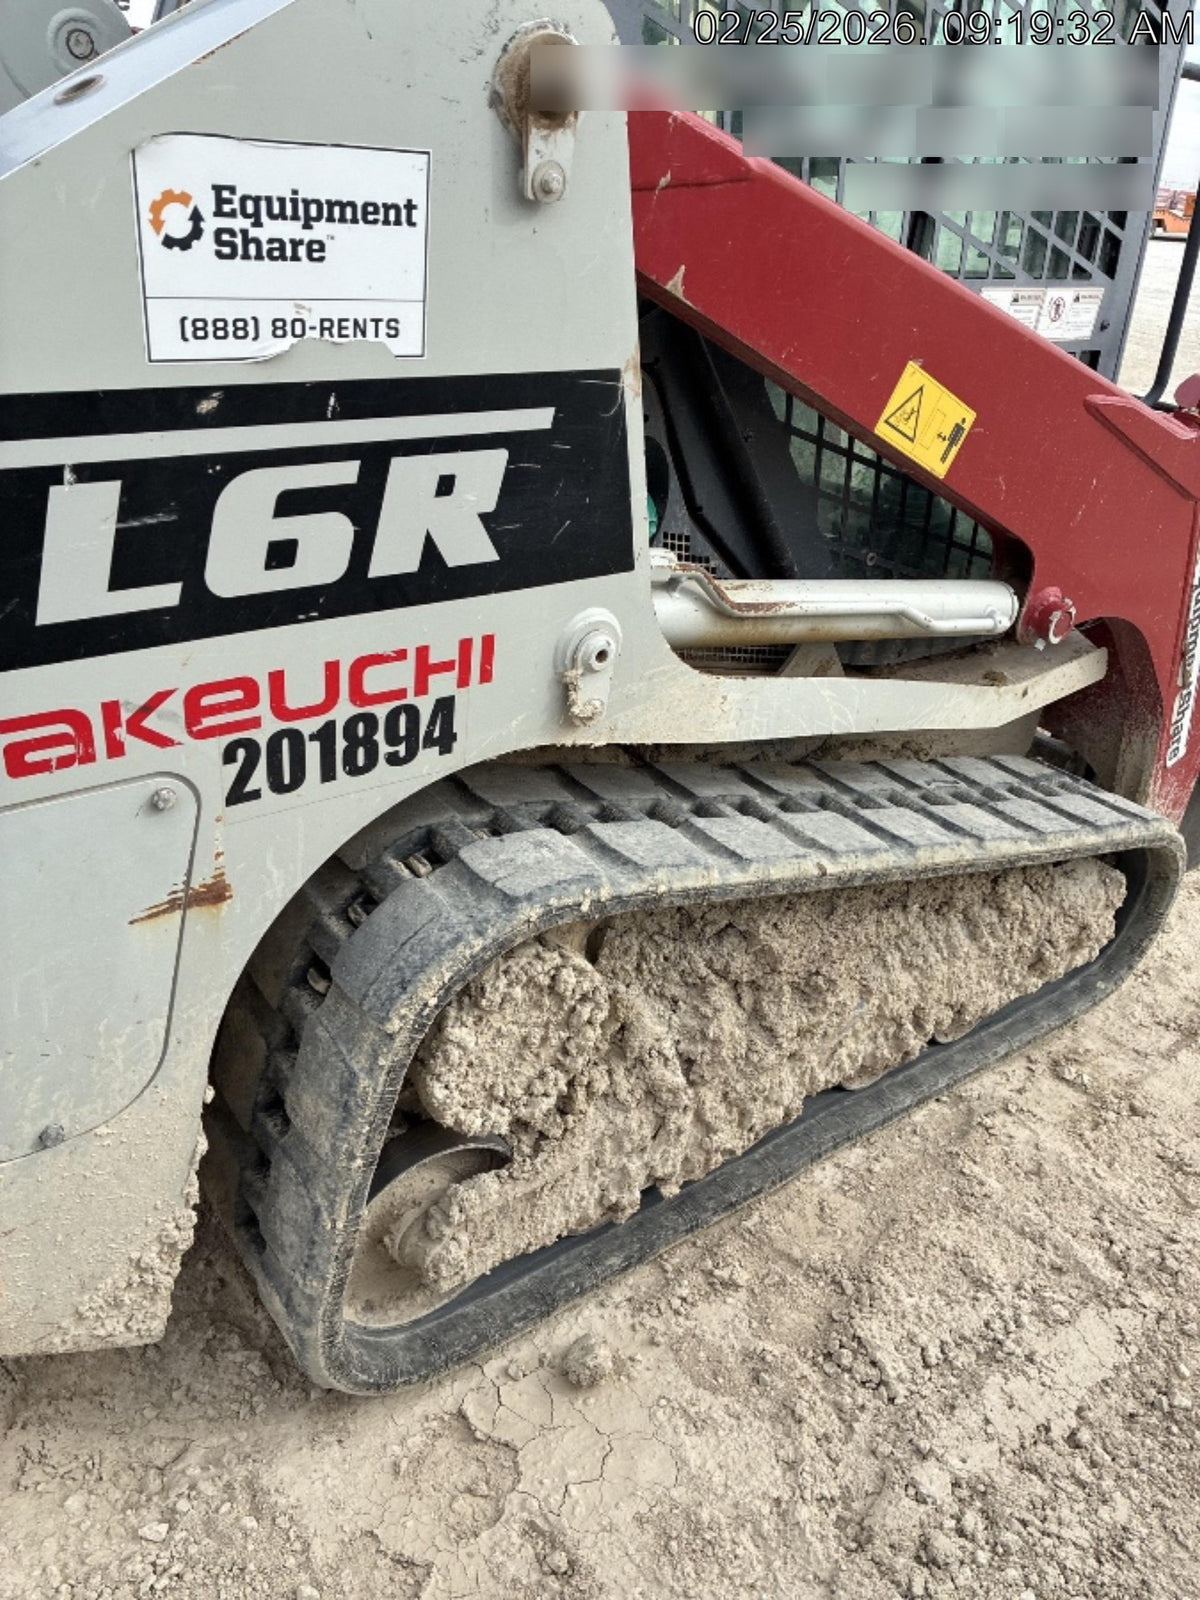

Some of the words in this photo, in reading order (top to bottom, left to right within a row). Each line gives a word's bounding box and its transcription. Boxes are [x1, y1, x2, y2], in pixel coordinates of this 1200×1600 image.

[211, 184, 418, 230] Equipment
[213, 227, 326, 263] Share
[180, 316, 260, 342] (888)
[271, 317, 400, 341] 80-RENTS
[36, 447, 509, 626] L6R
[222, 695, 458, 807] 201894
